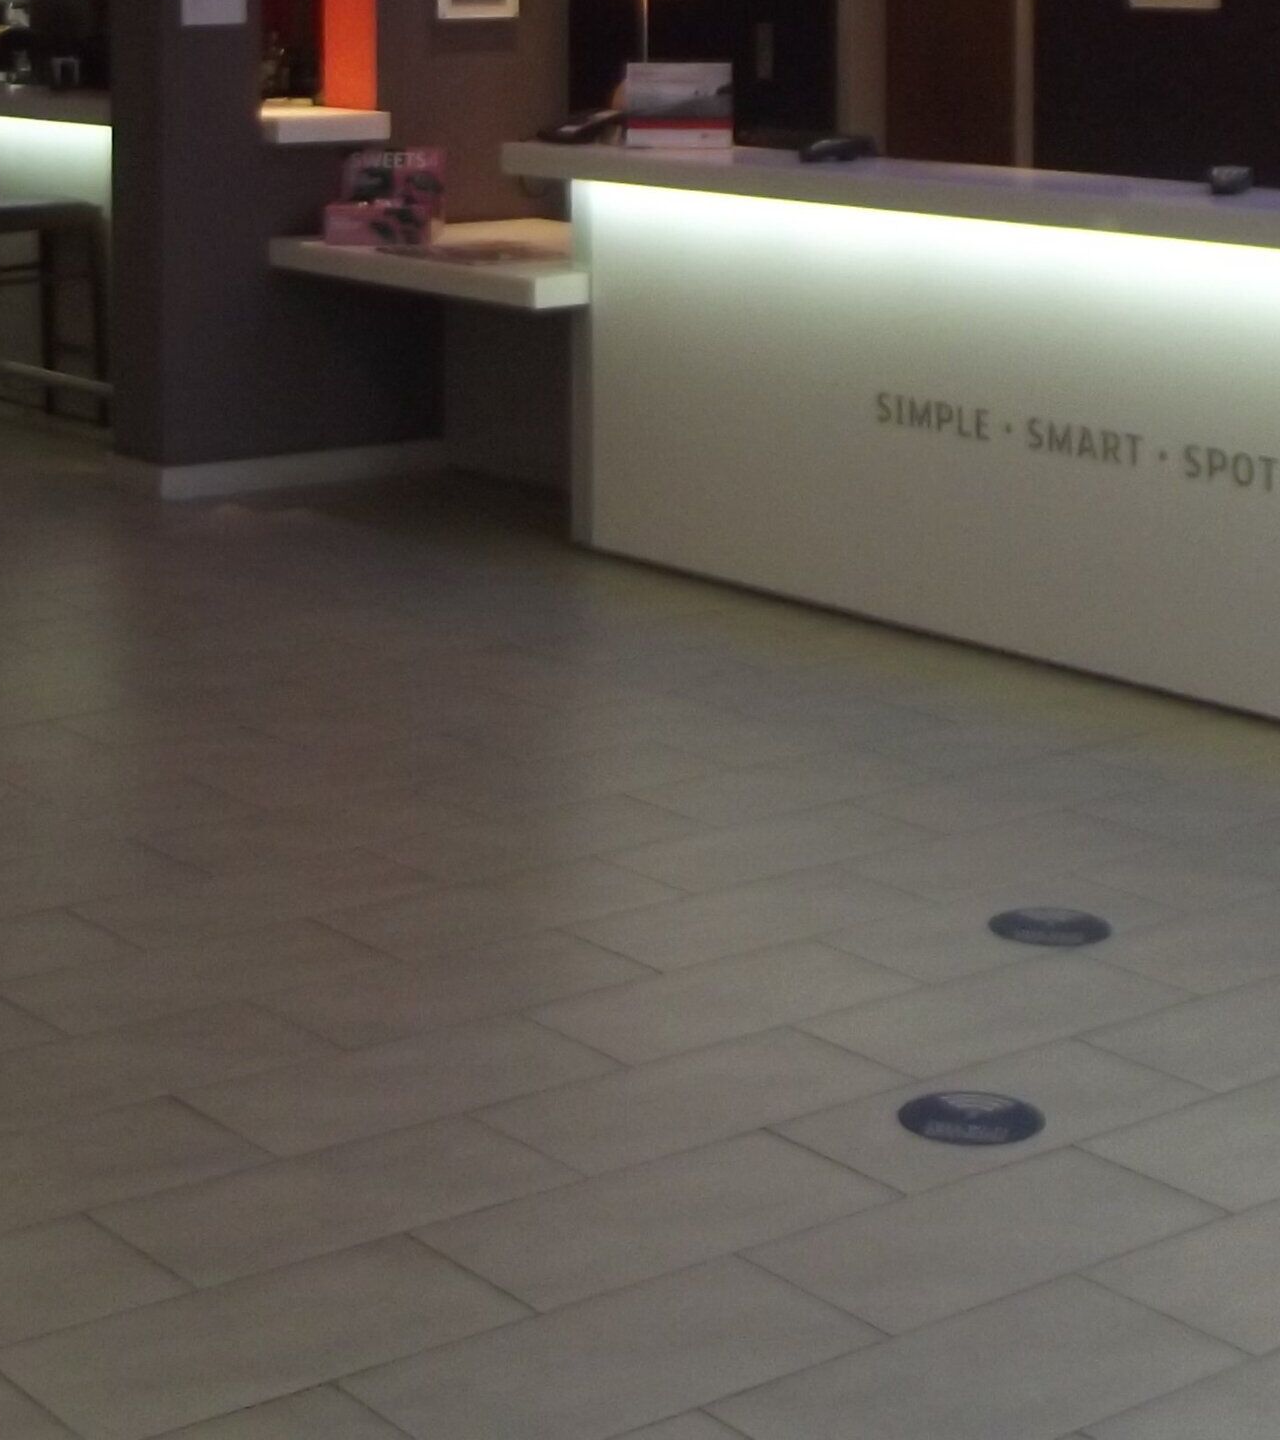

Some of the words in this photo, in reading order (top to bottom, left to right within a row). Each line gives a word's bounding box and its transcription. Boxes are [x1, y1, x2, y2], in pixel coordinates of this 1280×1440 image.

[875, 391, 991, 442] SIMPLE
[1025, 416, 1144, 467] SMART
[1183, 443, 1278, 492] SPOT
